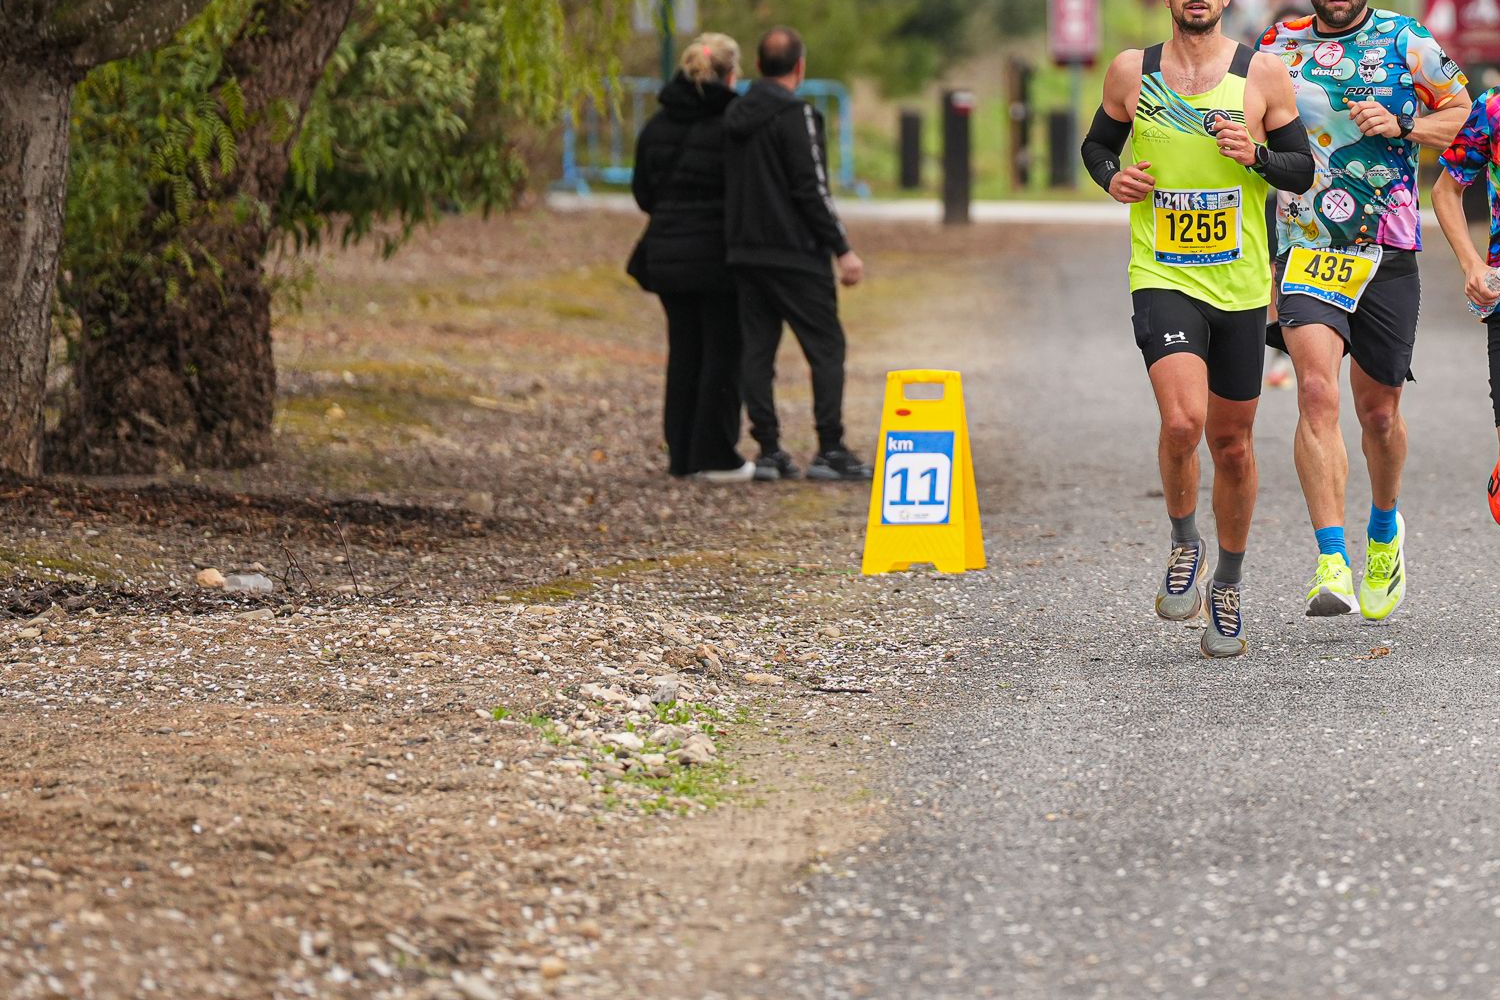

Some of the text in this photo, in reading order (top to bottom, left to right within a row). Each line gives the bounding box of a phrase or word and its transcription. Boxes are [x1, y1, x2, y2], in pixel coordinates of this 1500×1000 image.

[1345, 86, 1374, 96] PDA
[1163, 192, 1191, 210] 21K
[1165, 211, 1227, 243] 1255
[1304, 253, 1355, 283] 435
[888, 436, 914, 451] km
[889, 467, 945, 506] 11
